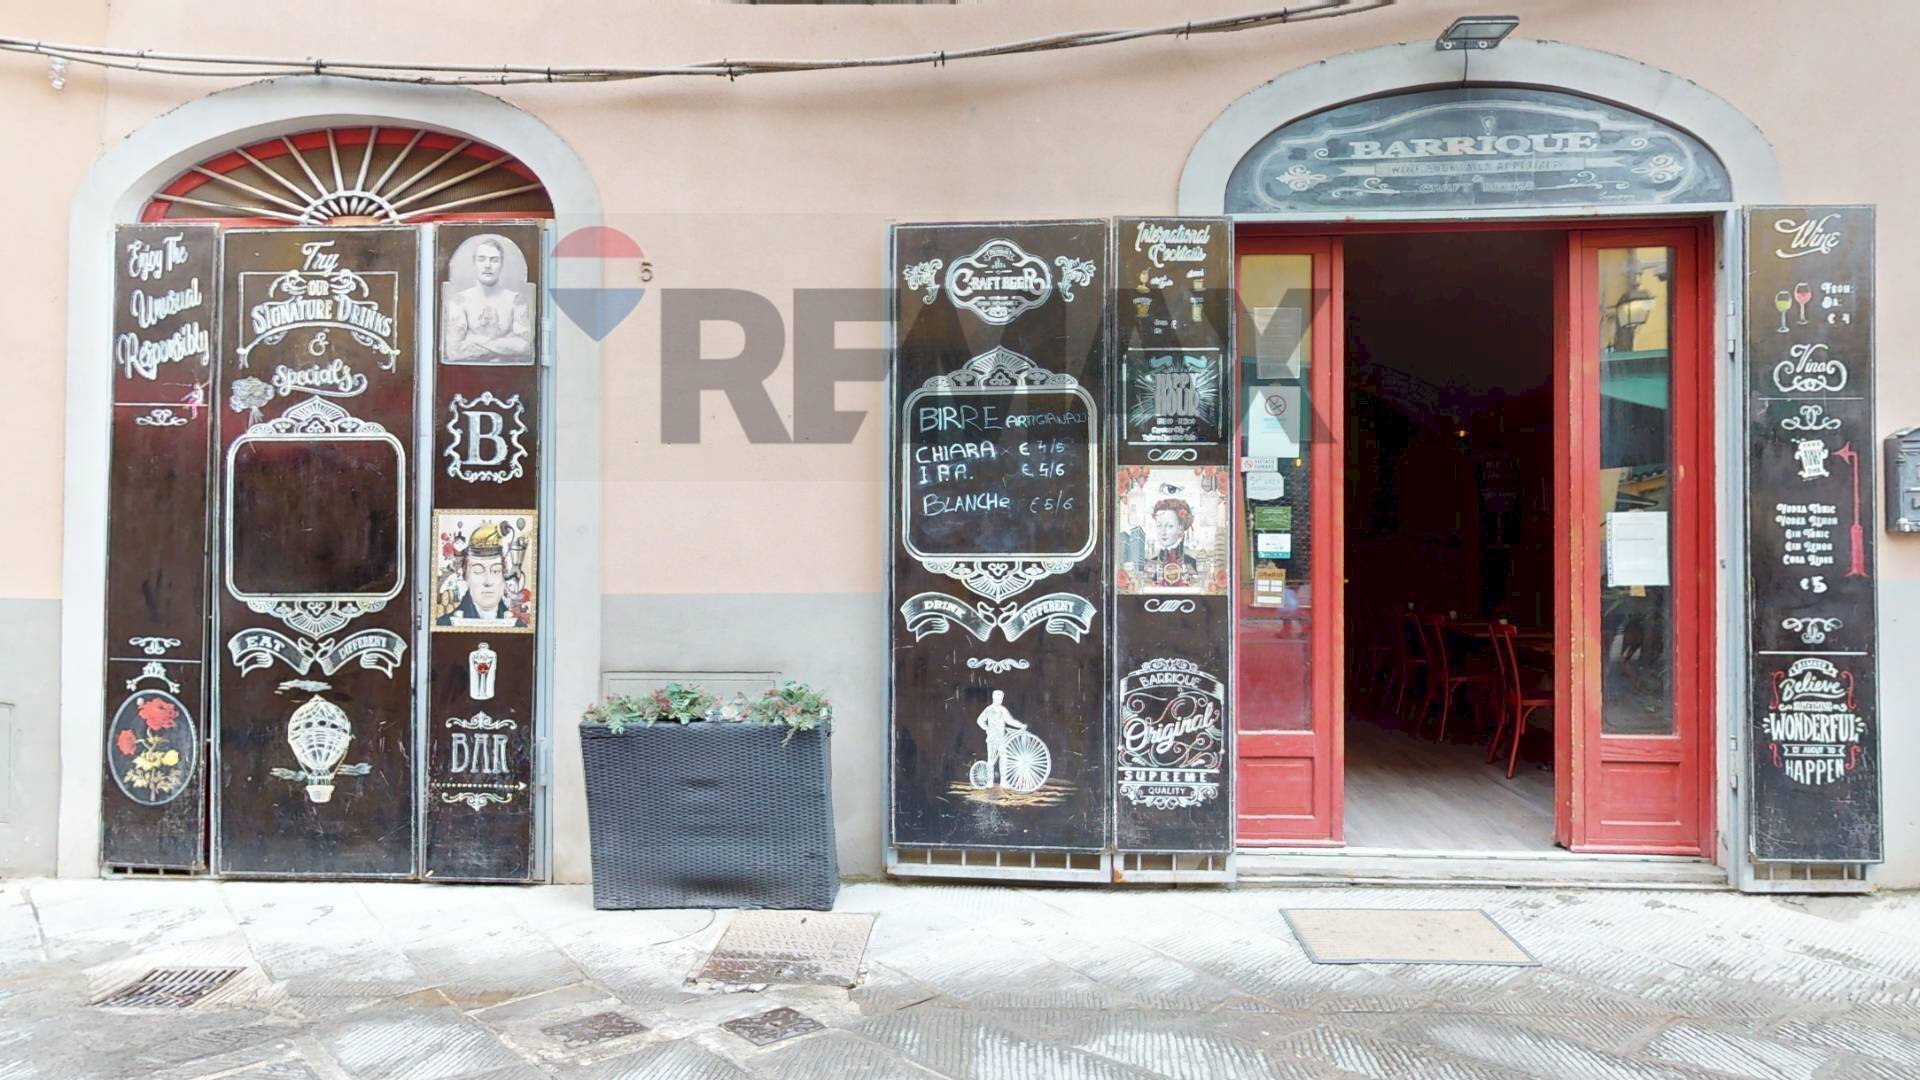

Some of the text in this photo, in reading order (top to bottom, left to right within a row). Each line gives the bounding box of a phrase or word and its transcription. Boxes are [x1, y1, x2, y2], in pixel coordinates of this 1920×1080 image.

[1349, 132, 1598, 158] BARRIQUE
[1135, 222, 1211, 252] International
[1774, 213, 1841, 258] Wine
[127, 232, 189, 281] Enjoy The
[302, 240, 340, 277] Try
[1148, 243, 1207, 268] Cocktails
[641, 261, 654, 282] 5
[953, 268, 1046, 296] CRAFT BEER
[307, 280, 330, 296] OUR
[130, 277, 203, 329] Unusual
[251, 294, 393, 337] SIGNATURE DRINKS
[308, 328, 330, 356] &
[1790, 344, 1836, 374] Vino
[272, 358, 367, 397] Specials
[919, 405, 1002, 433] BIRRE
[460, 411, 508, 465] B
[916, 440, 996, 464] CHIARA
[923, 600, 1075, 626] DRINK DIFFERENT
[245, 635, 387, 660] EAT DIFFERENT
[1138, 672, 1203, 688] BARRIQUE
[1779, 671, 1845, 701] Believe
[1123, 702, 1215, 754] Original
[1769, 712, 1859, 743] WONDERFUL
[451, 733, 509, 774] BAR
[1123, 770, 1209, 783] SUPREME
[1785, 759, 1845, 785] HAPPEN
[1147, 786, 1187, 796] QUALITY
